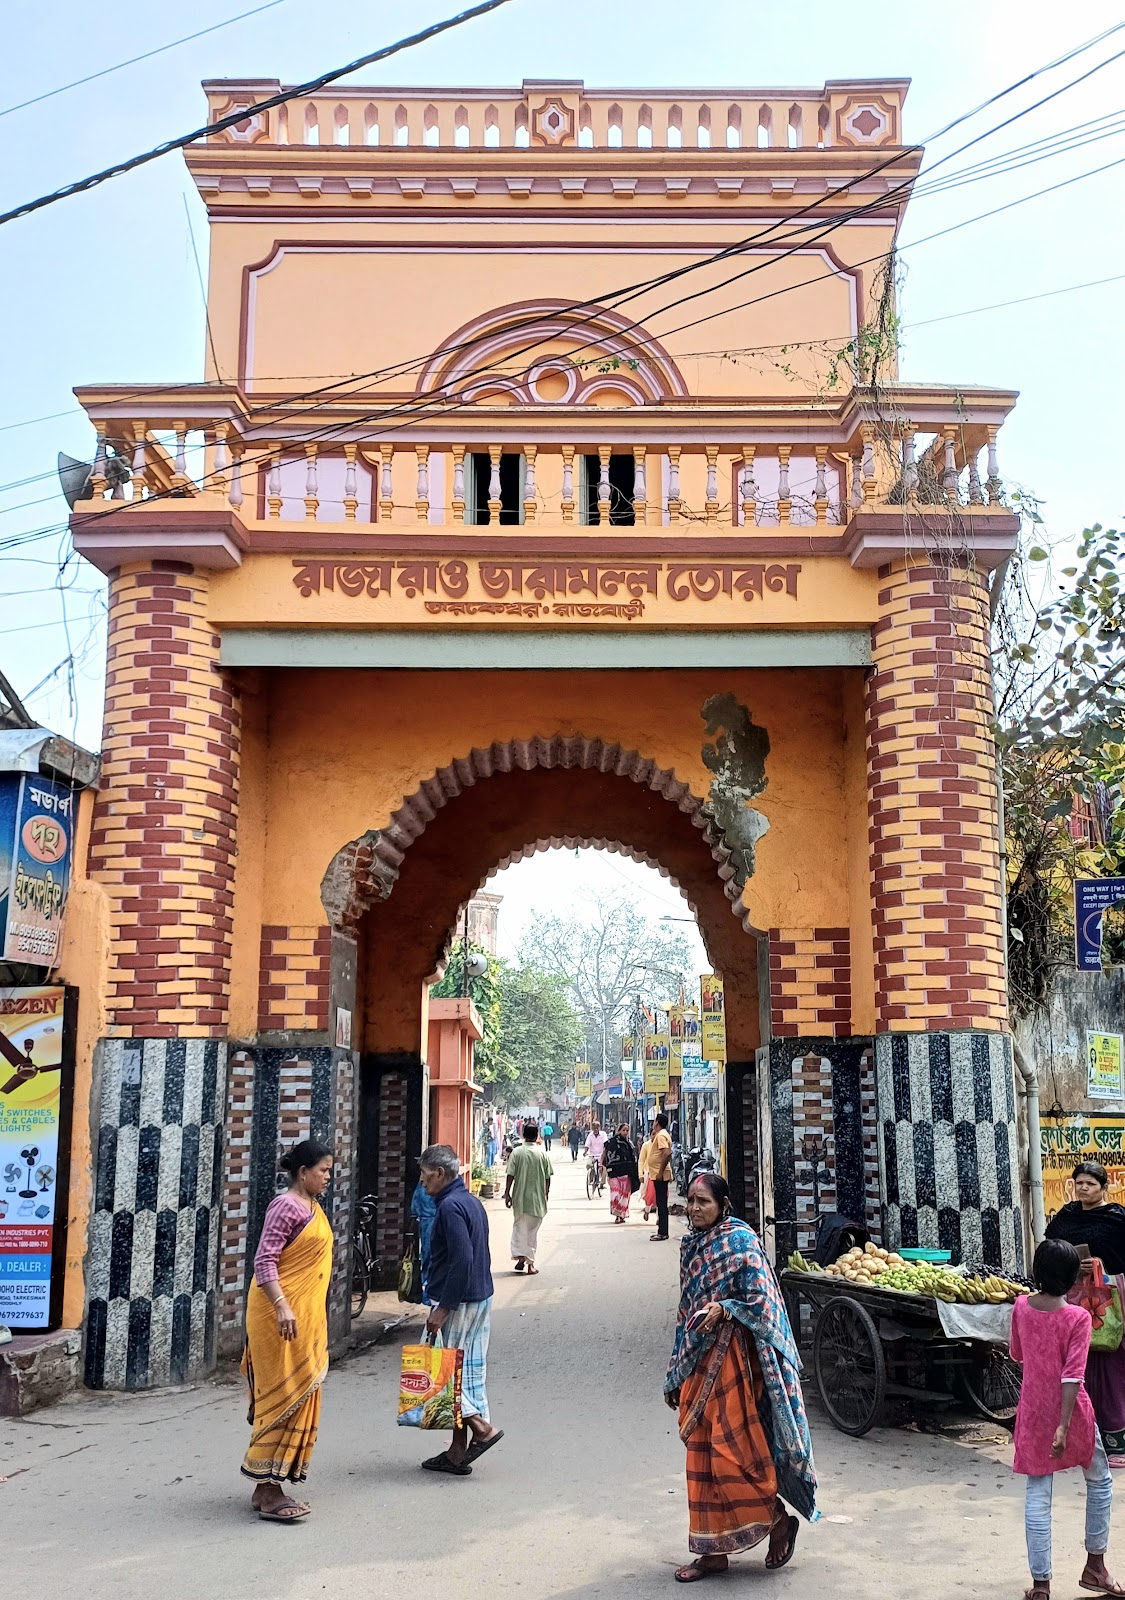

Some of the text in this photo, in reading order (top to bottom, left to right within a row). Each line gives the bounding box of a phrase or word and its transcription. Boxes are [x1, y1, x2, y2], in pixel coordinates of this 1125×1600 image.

[292, 560, 395, 598] রাজা
[397, 560, 469, 599] রাও
[667, 563, 802, 602] তোরণ
[552, 599, 646, 621] রাজবাড়ী
[0, 998, 58, 1014] EZEN
[6, 1108, 52, 1116] SWITCHES
[7, 1261, 41, 1272] DEALER
[0, 1285, 46, 1294] OHO ELECTRIC
